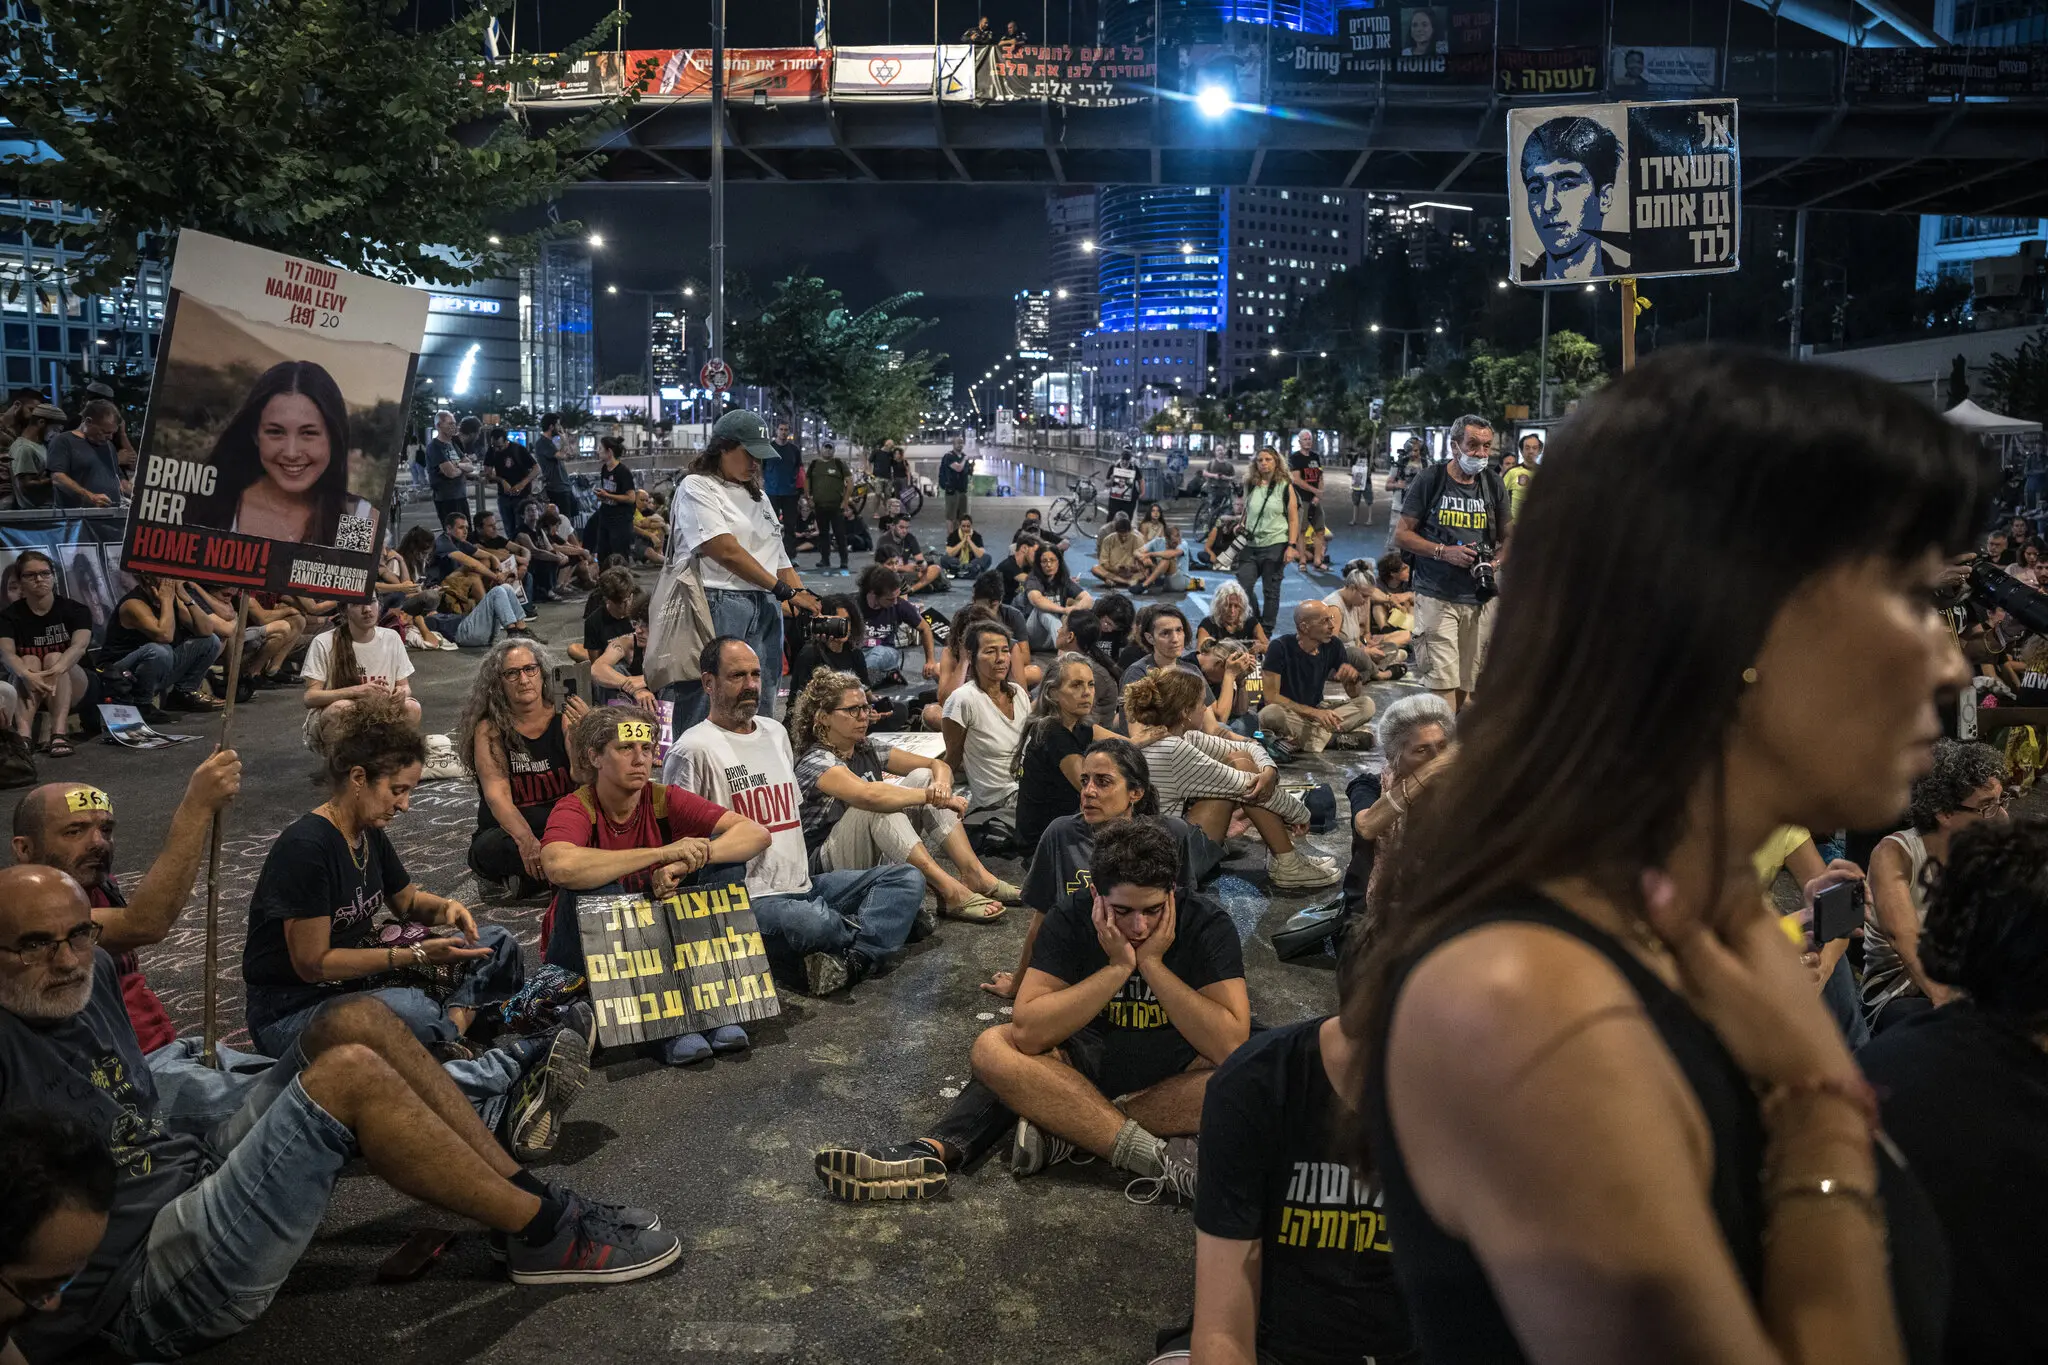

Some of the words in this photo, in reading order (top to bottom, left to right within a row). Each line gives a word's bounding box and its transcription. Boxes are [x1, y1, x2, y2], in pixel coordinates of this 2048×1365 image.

[1349, 15, 1391, 34] מחזירים
[1349, 34, 1374, 51] ענבר
[1375, 33, 1392, 49] את
[780, 56, 826, 71] לשחרר
[1121, 45, 1144, 60] כל
[1294, 45, 1341, 75] Bring
[755, 58, 776, 71] את
[1034, 64, 1060, 77] את
[1067, 63, 1093, 78] לנו
[1029, 82, 1072, 96] אלבג
[1079, 81, 1114, 96] לירי
[1521, 65, 1597, 93] לעסקה
[1697, 110, 1729, 149] אל
[1639, 153, 1730, 191] תשאירו
[1636, 193, 1697, 229] אותם
[1702, 191, 1731, 225] גם
[1688, 224, 1730, 264] לבד
[285, 260, 303, 281] לוי
[304, 265, 338, 290] נעמה
[265, 277, 312, 305] NAAMA
[315, 290, 347, 313] LEVY
[320, 312, 340, 328] 20
[145, 455, 218, 497] BRING
[138, 488, 187, 526] HER
[132, 525, 201, 564] HOME
[203, 537, 271, 574] NOW!
[292, 559, 326, 574] HOSTAGES
[325, 564, 340, 576] AND
[340, 566, 369, 580] MISSING
[290, 569, 332, 588] FAMILIES
[333, 575, 367, 593] FORUM
[623, 723, 652, 738] 367
[511, 761, 532, 773] THEM
[531, 759, 551, 772] HOME
[724, 764, 748, 781] BRING
[728, 776, 750, 793] THEM
[748, 772, 768, 787] HOME
[75, 791, 111, 808] 36
[663, 883, 750, 921] לעצור
[673, 926, 766, 971] מלחמת
[586, 941, 664, 983] שלום
[691, 972, 777, 1011] נתניהו
[1285, 1161, 1351, 1205] שנה
